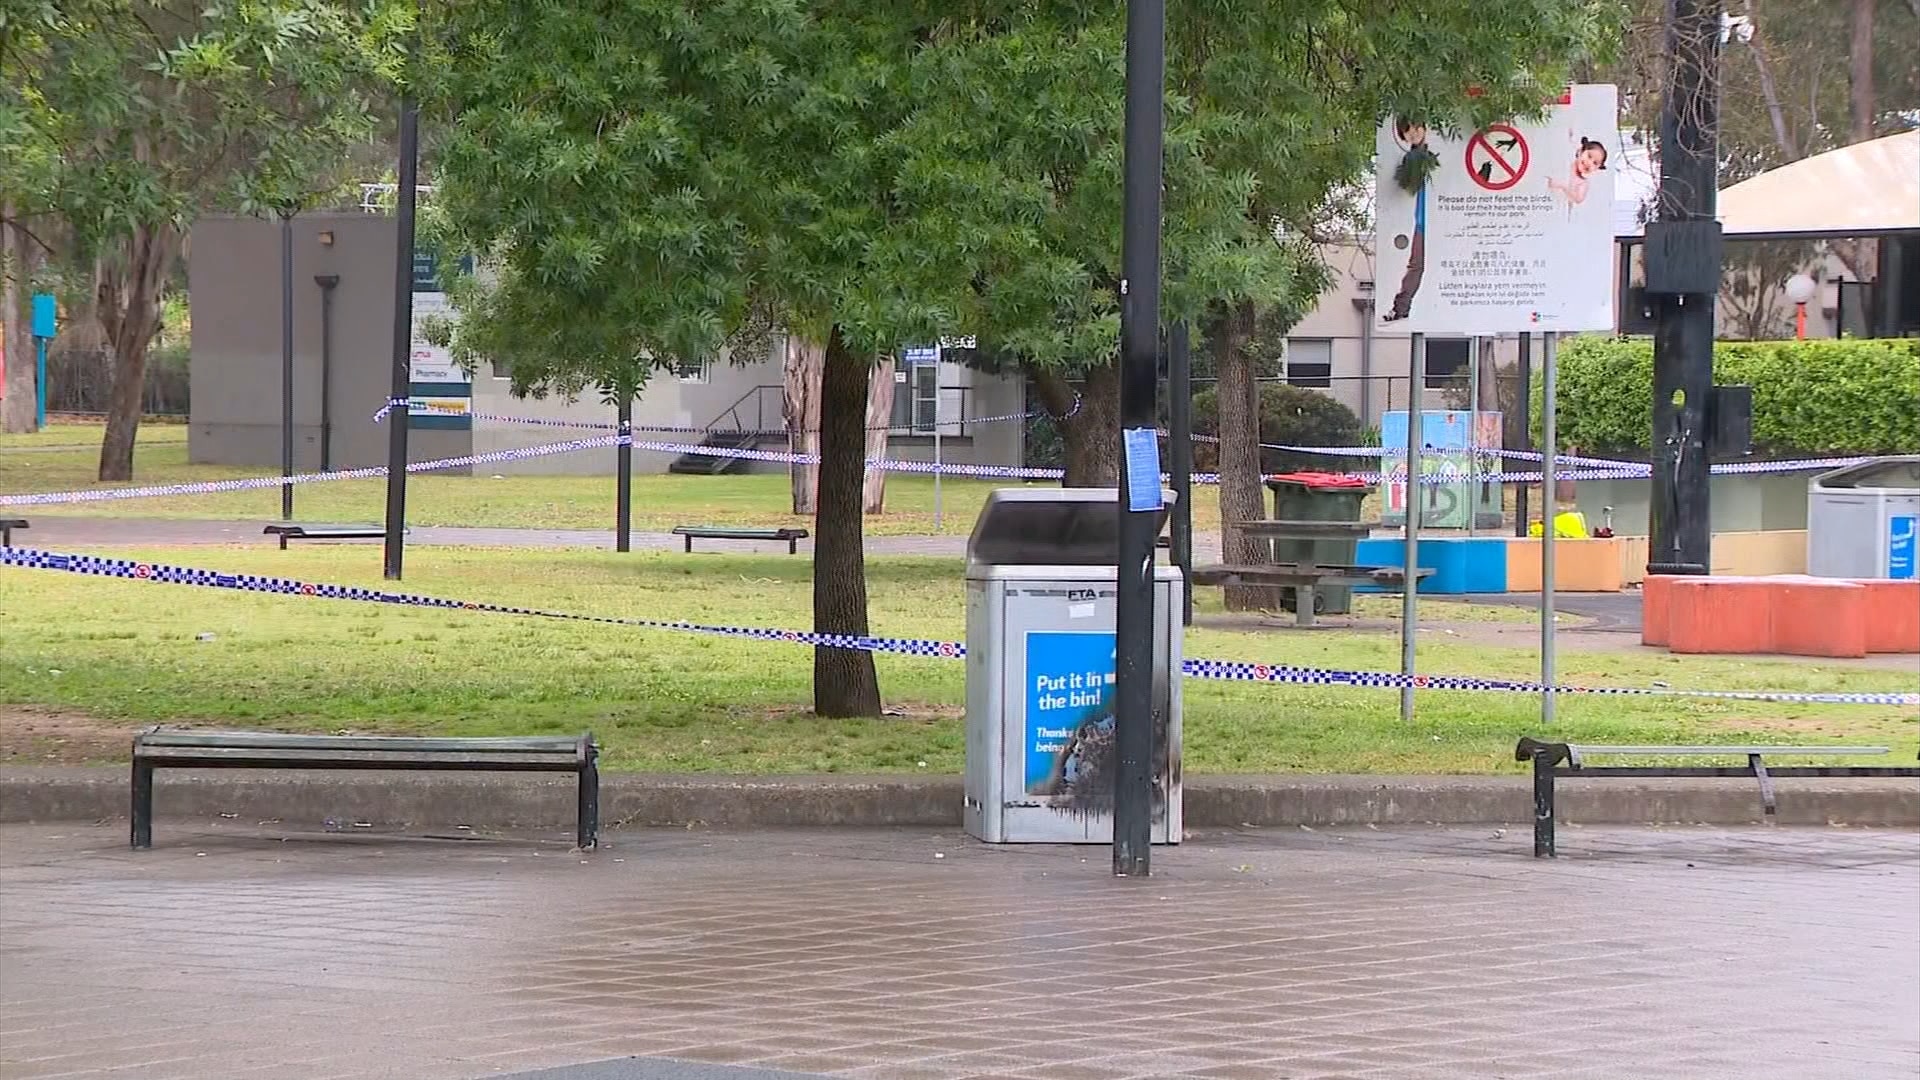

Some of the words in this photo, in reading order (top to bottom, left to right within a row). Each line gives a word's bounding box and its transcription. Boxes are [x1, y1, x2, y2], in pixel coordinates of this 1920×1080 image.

[1438, 195, 1464, 203] Please
[1466, 195, 1477, 203] do
[1479, 195, 1493, 203] not
[1494, 195, 1513, 203] feed
[1515, 195, 1528, 203] the
[1532, 204, 1553, 212] brings
[1439, 282, 1463, 290] Lütfen
[1068, 589, 1096, 599] FTA
[1037, 675, 1066, 692] Put
[1069, 673, 1083, 688] it
[1086, 672, 1101, 687] in
[1038, 693, 1066, 710] the
[1070, 688, 1100, 707] bin!
